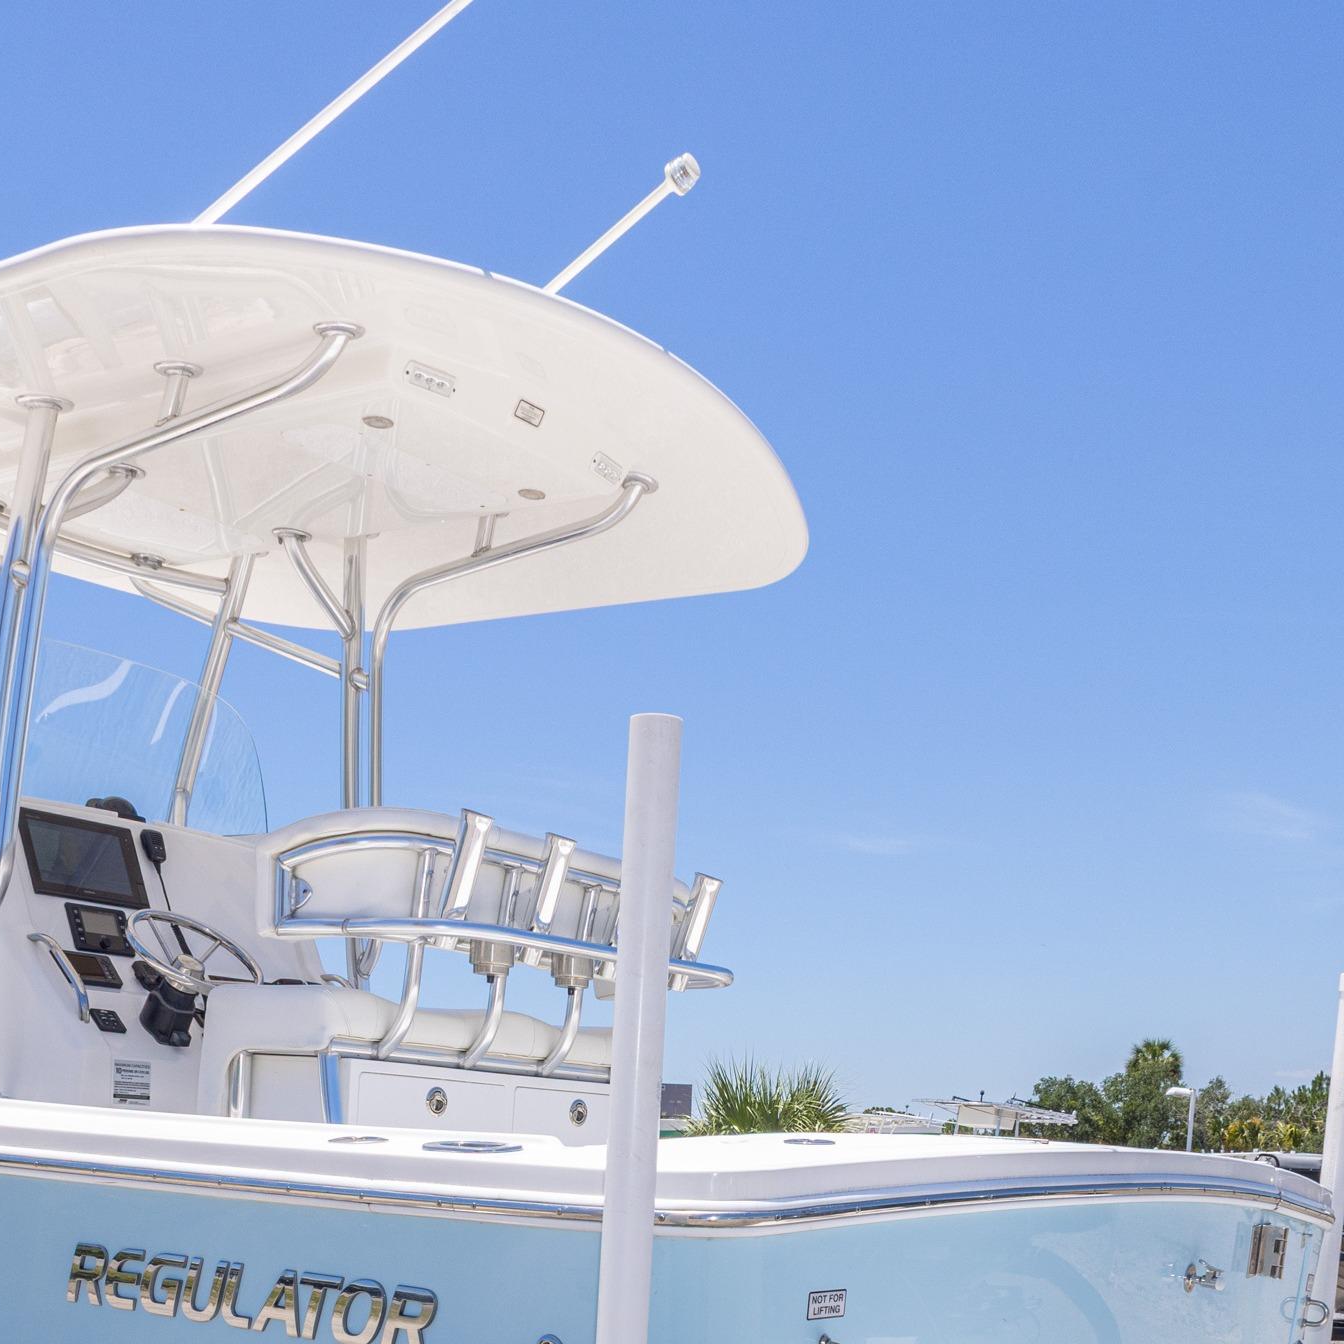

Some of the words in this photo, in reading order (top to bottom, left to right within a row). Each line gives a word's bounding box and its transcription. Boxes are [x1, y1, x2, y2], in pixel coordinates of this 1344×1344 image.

[812, 1294, 827, 1304] NOT
[828, 1293, 844, 1303] FOR
[813, 1304, 841, 1316] LIFTING
